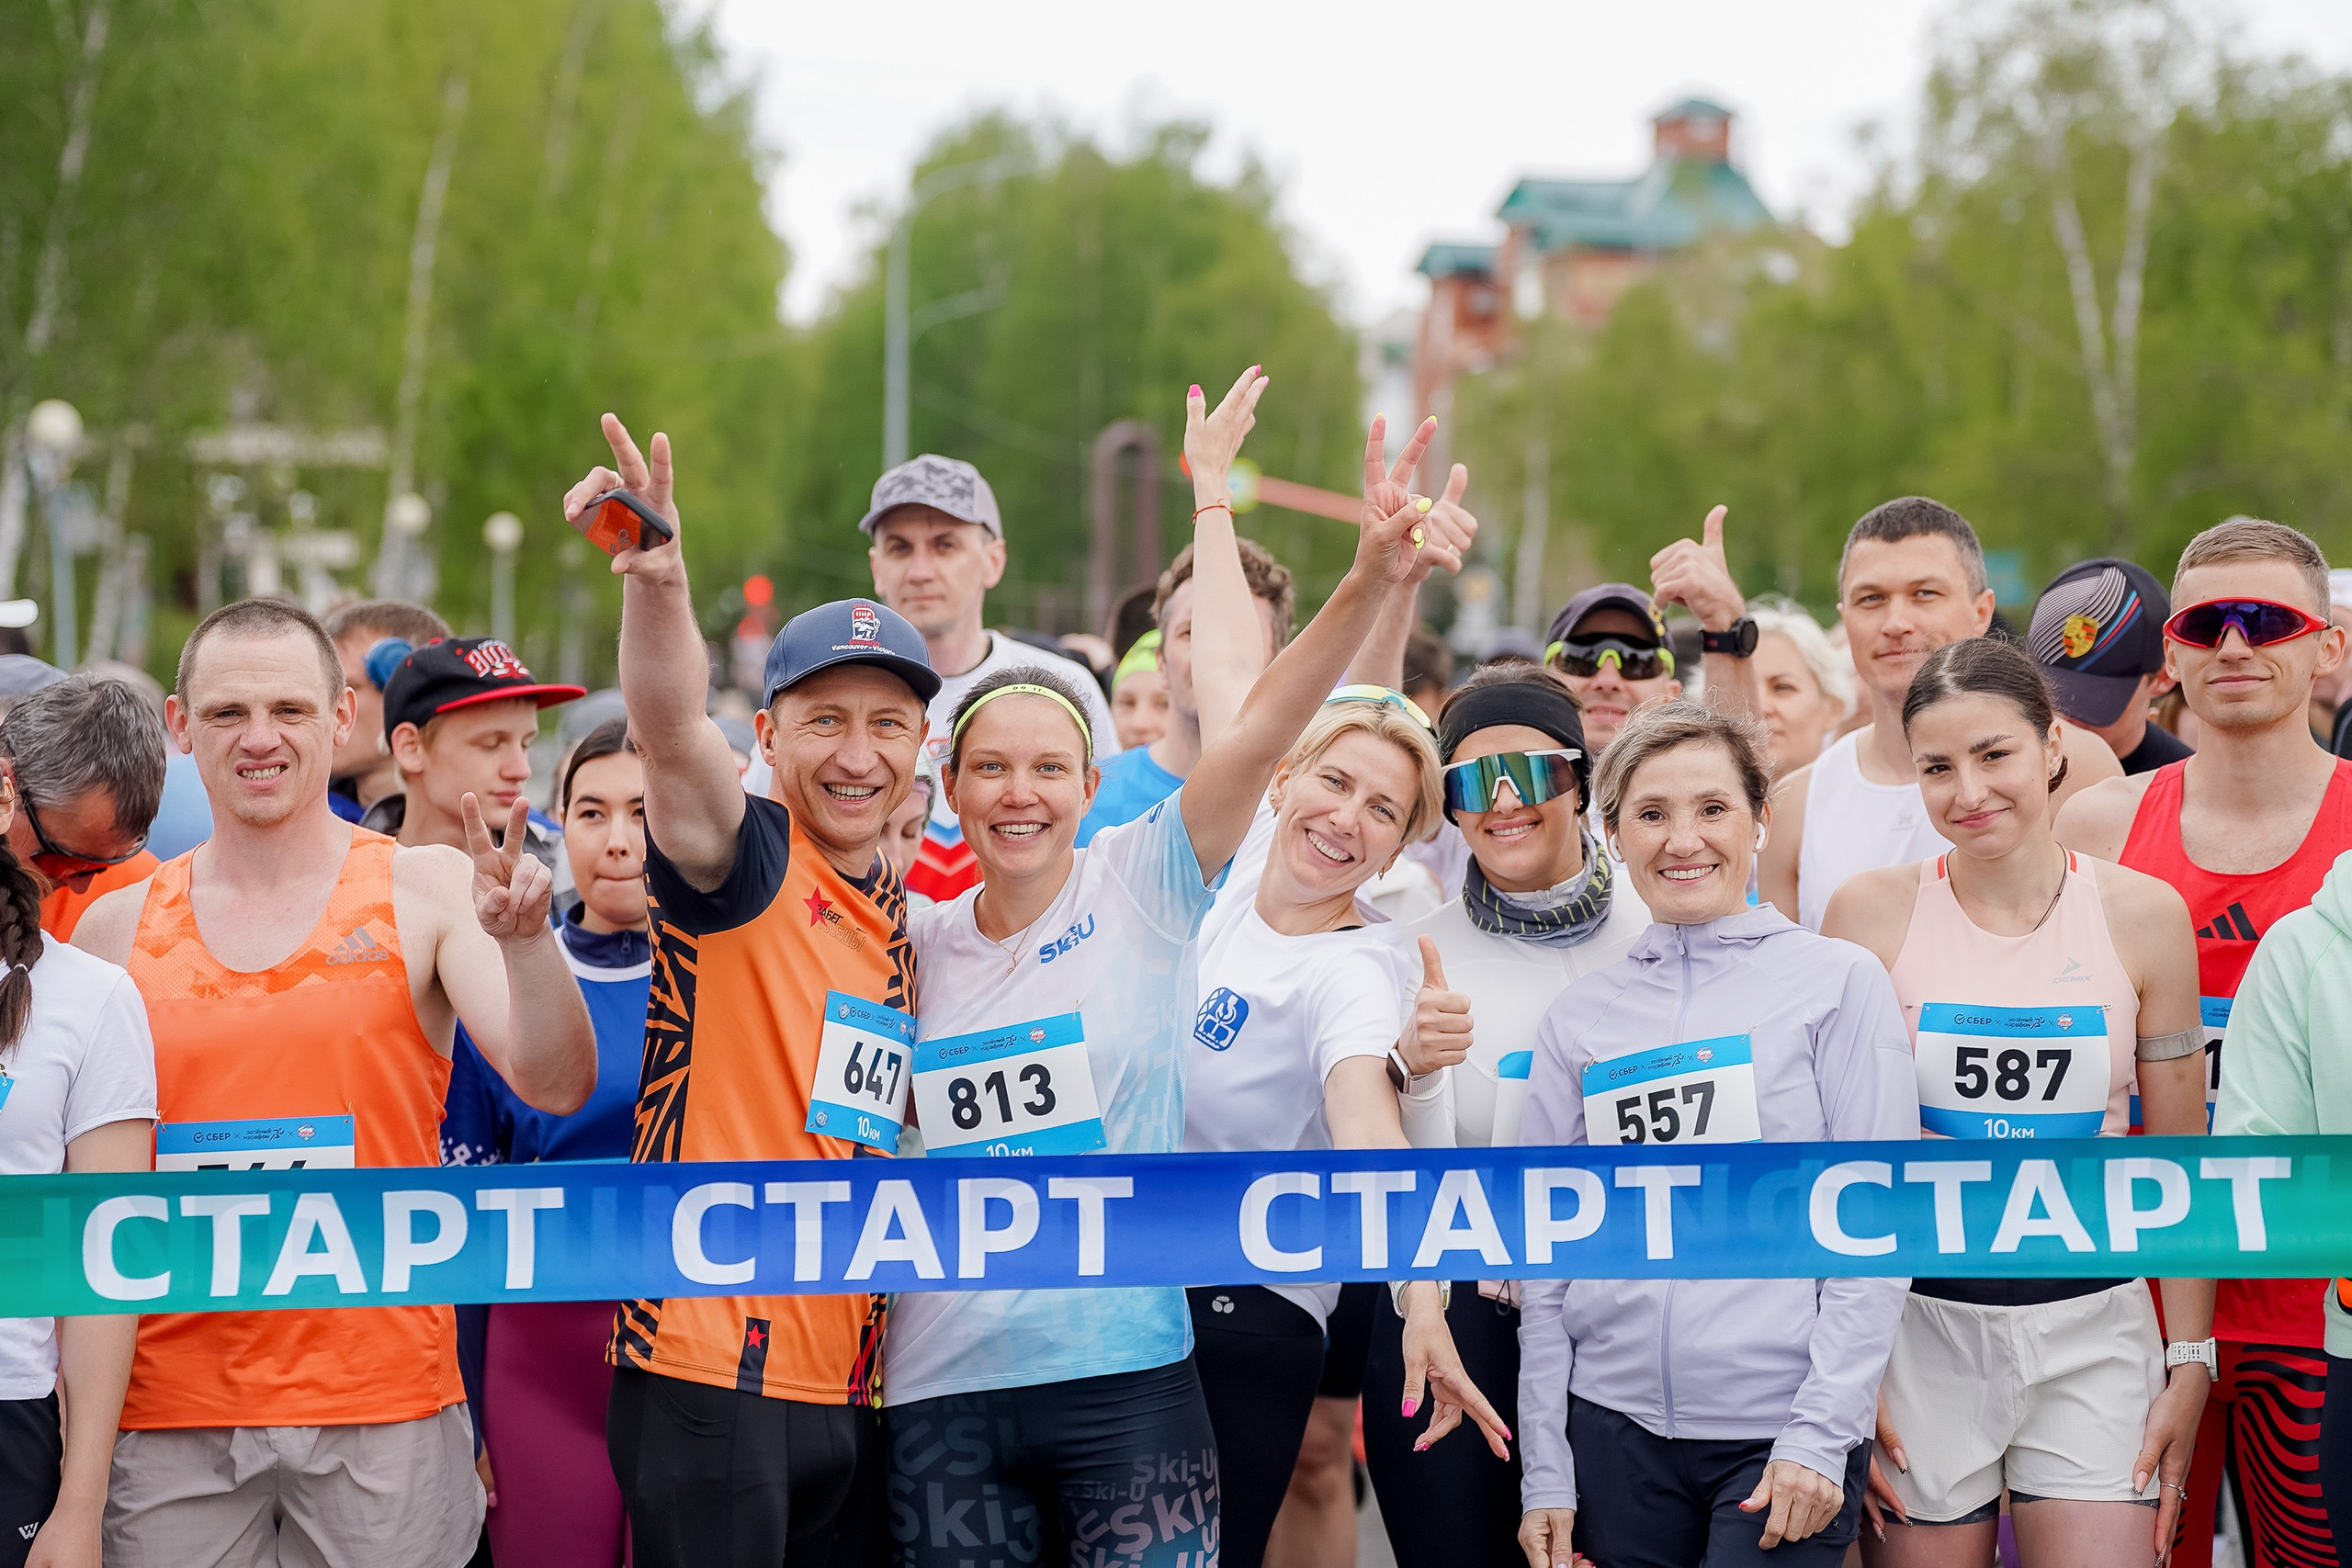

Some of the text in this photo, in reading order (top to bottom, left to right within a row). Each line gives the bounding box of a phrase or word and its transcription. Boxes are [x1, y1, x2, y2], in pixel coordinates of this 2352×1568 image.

[325, 949, 390, 965] adidas
[1966, 1017, 1992, 1025] СБЕР
[948, 1046, 970, 1056] СБЕР
[843, 1041, 903, 1106] 647
[1618, 1066, 1638, 1077] СБЕР
[1954, 1046, 2072, 1101] 587
[948, 1064, 1056, 1130] 813
[1615, 1080, 1715, 1145] 557
[206, 1133, 231, 1142] СБЕР
[82, 1187, 564, 1301] СТАРТ
[672, 1177, 1134, 1285] СТАРТ
[1238, 1166, 1702, 1272] СТАРТ
[1809, 1157, 2291, 1257] СТАРТ
